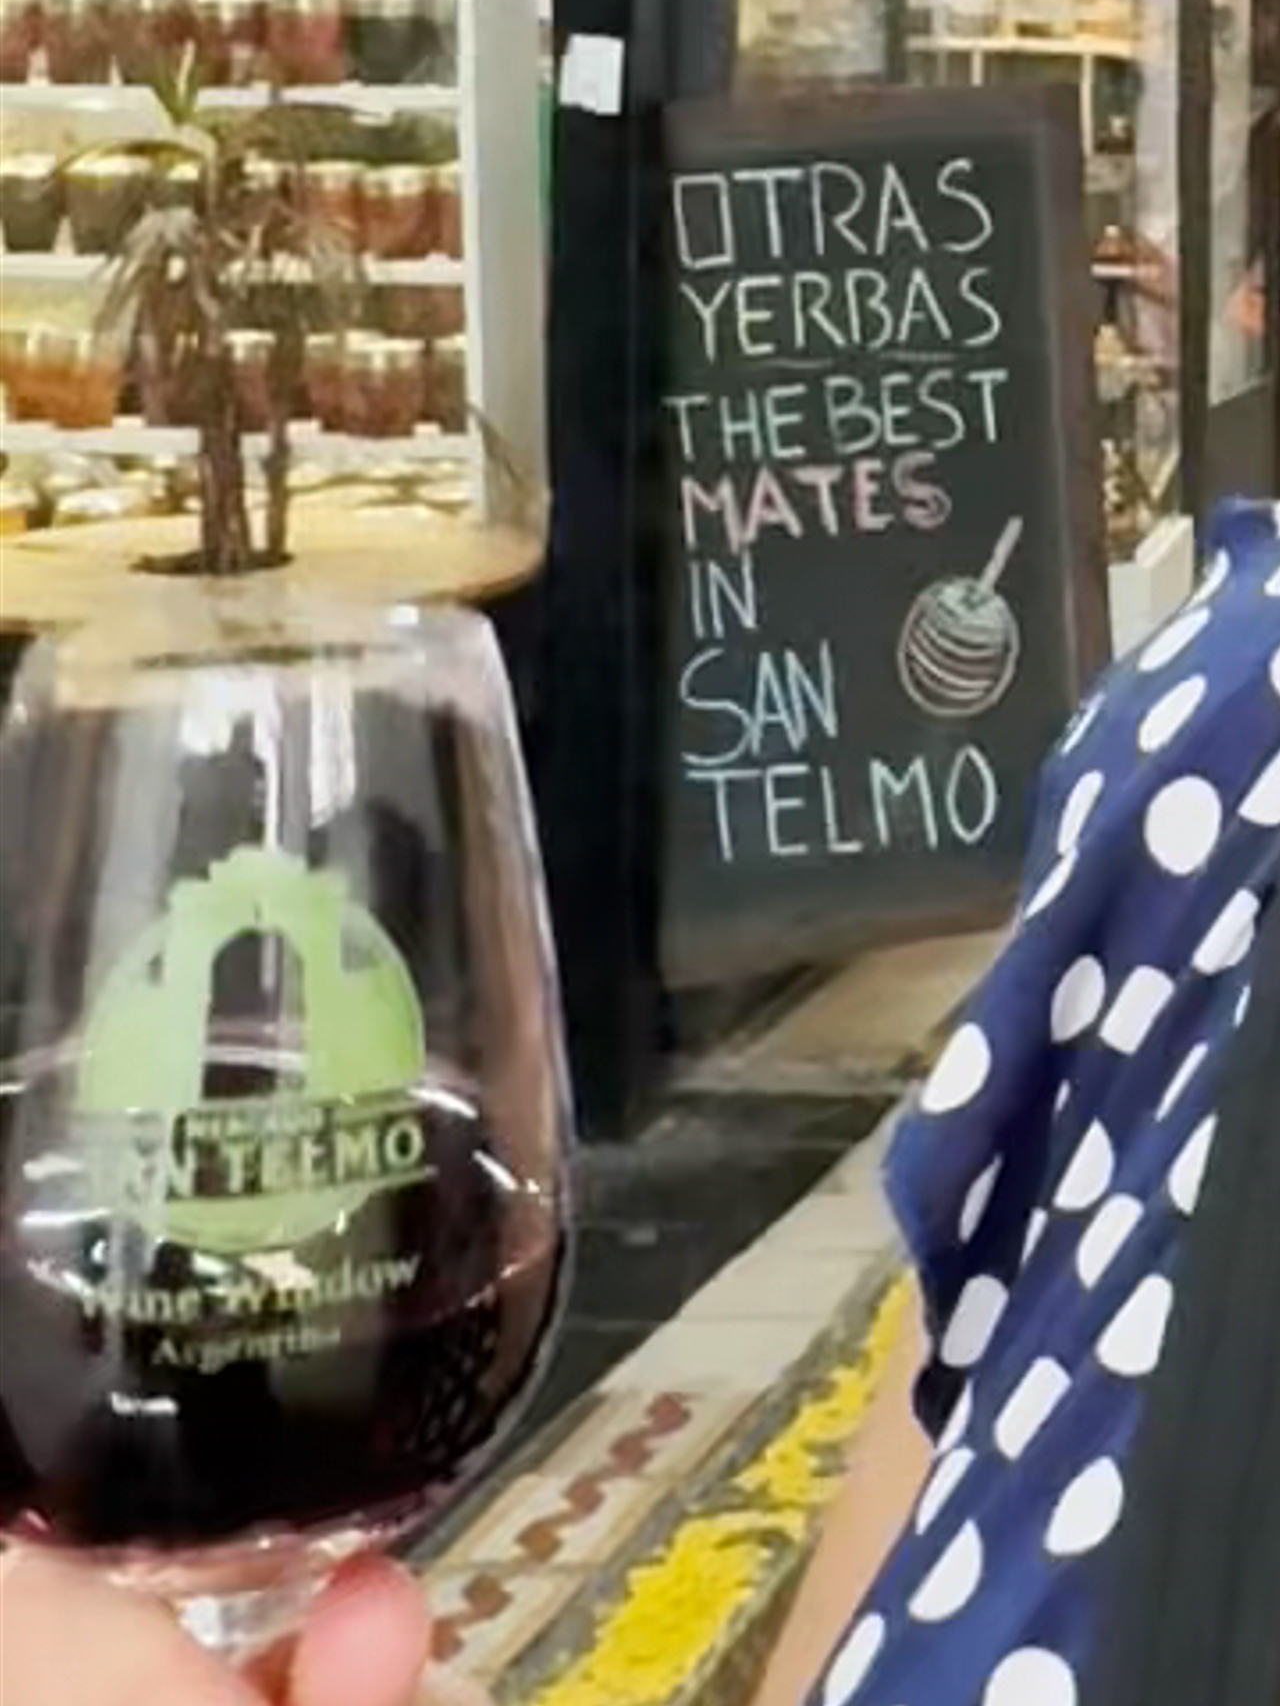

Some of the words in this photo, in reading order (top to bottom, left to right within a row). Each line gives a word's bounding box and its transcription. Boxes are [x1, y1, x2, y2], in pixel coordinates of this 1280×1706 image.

[673, 158, 993, 270] OTRAS
[680, 268, 1001, 364] YERBAS
[664, 385, 806, 462] THE
[823, 369, 1008, 454] BEST
[681, 450, 952, 554] MATES
[688, 550, 757, 638] IN
[680, 639, 838, 766] SAN
[686, 744, 998, 863] TELMO
